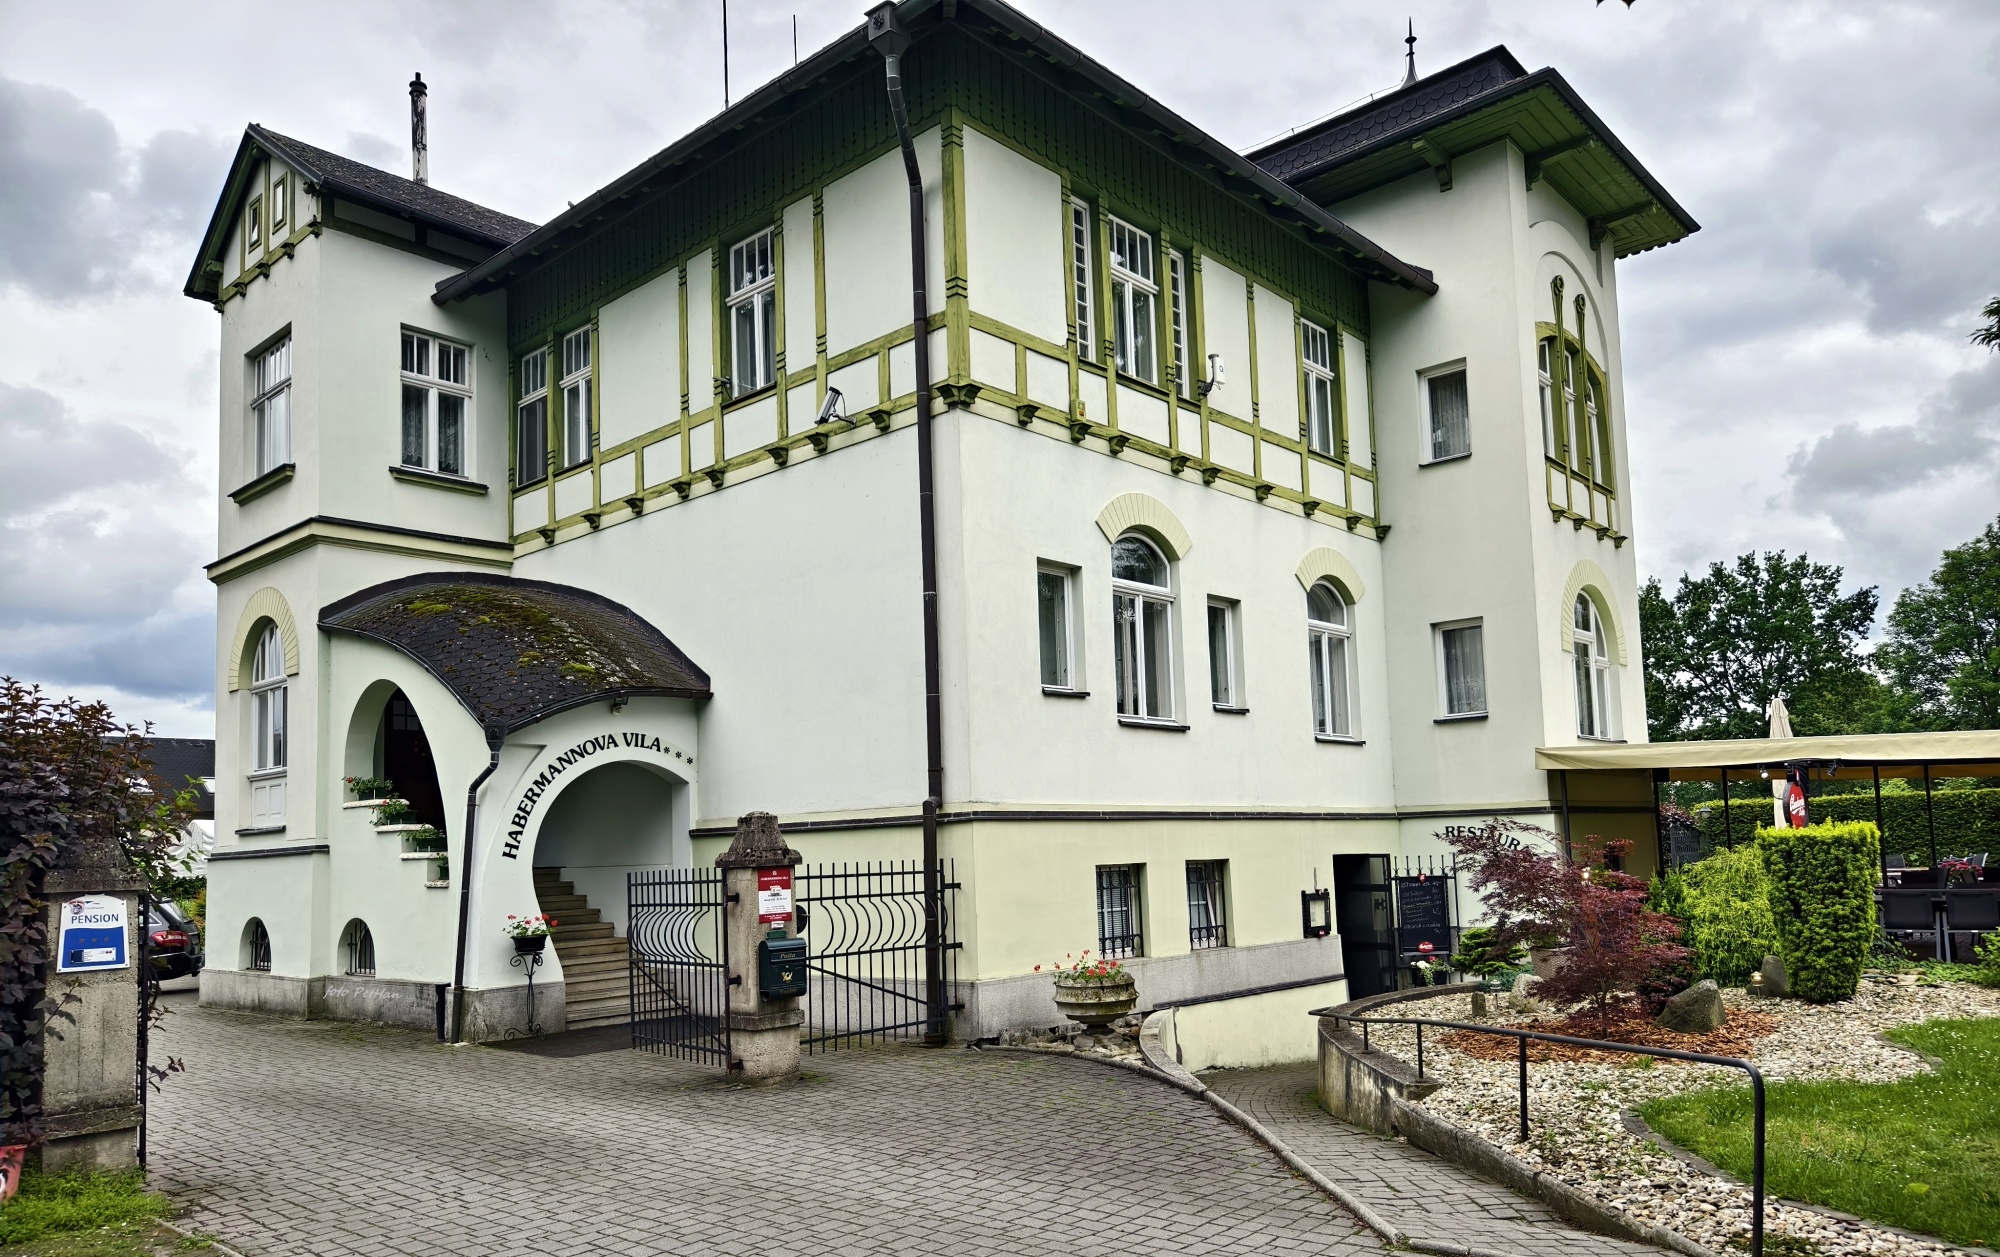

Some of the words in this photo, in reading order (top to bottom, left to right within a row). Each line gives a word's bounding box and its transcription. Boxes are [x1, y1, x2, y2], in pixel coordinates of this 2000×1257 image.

[502, 734, 619, 860] HABERMANNOVA
[622, 732, 662, 753] VILA
[71, 913, 119, 924] PENSION
